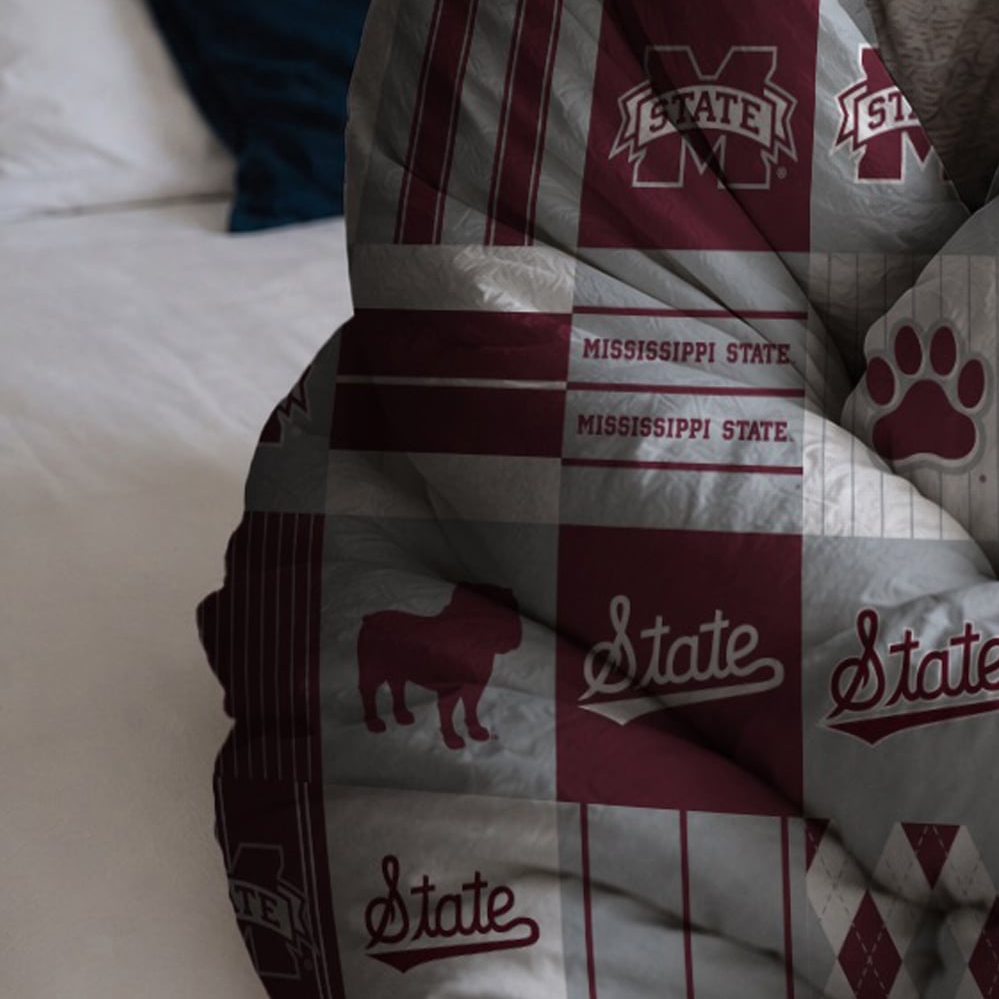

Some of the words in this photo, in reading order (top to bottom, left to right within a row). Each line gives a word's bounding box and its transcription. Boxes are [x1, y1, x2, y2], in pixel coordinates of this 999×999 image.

[648, 92, 762, 134] STATE
[582, 338, 716, 363] MISSISSIPPI
[726, 342, 790, 365] STATE
[577, 414, 711, 439] MISSISSIPPI
[578, 595, 785, 725] State
[365, 855, 540, 973] State
